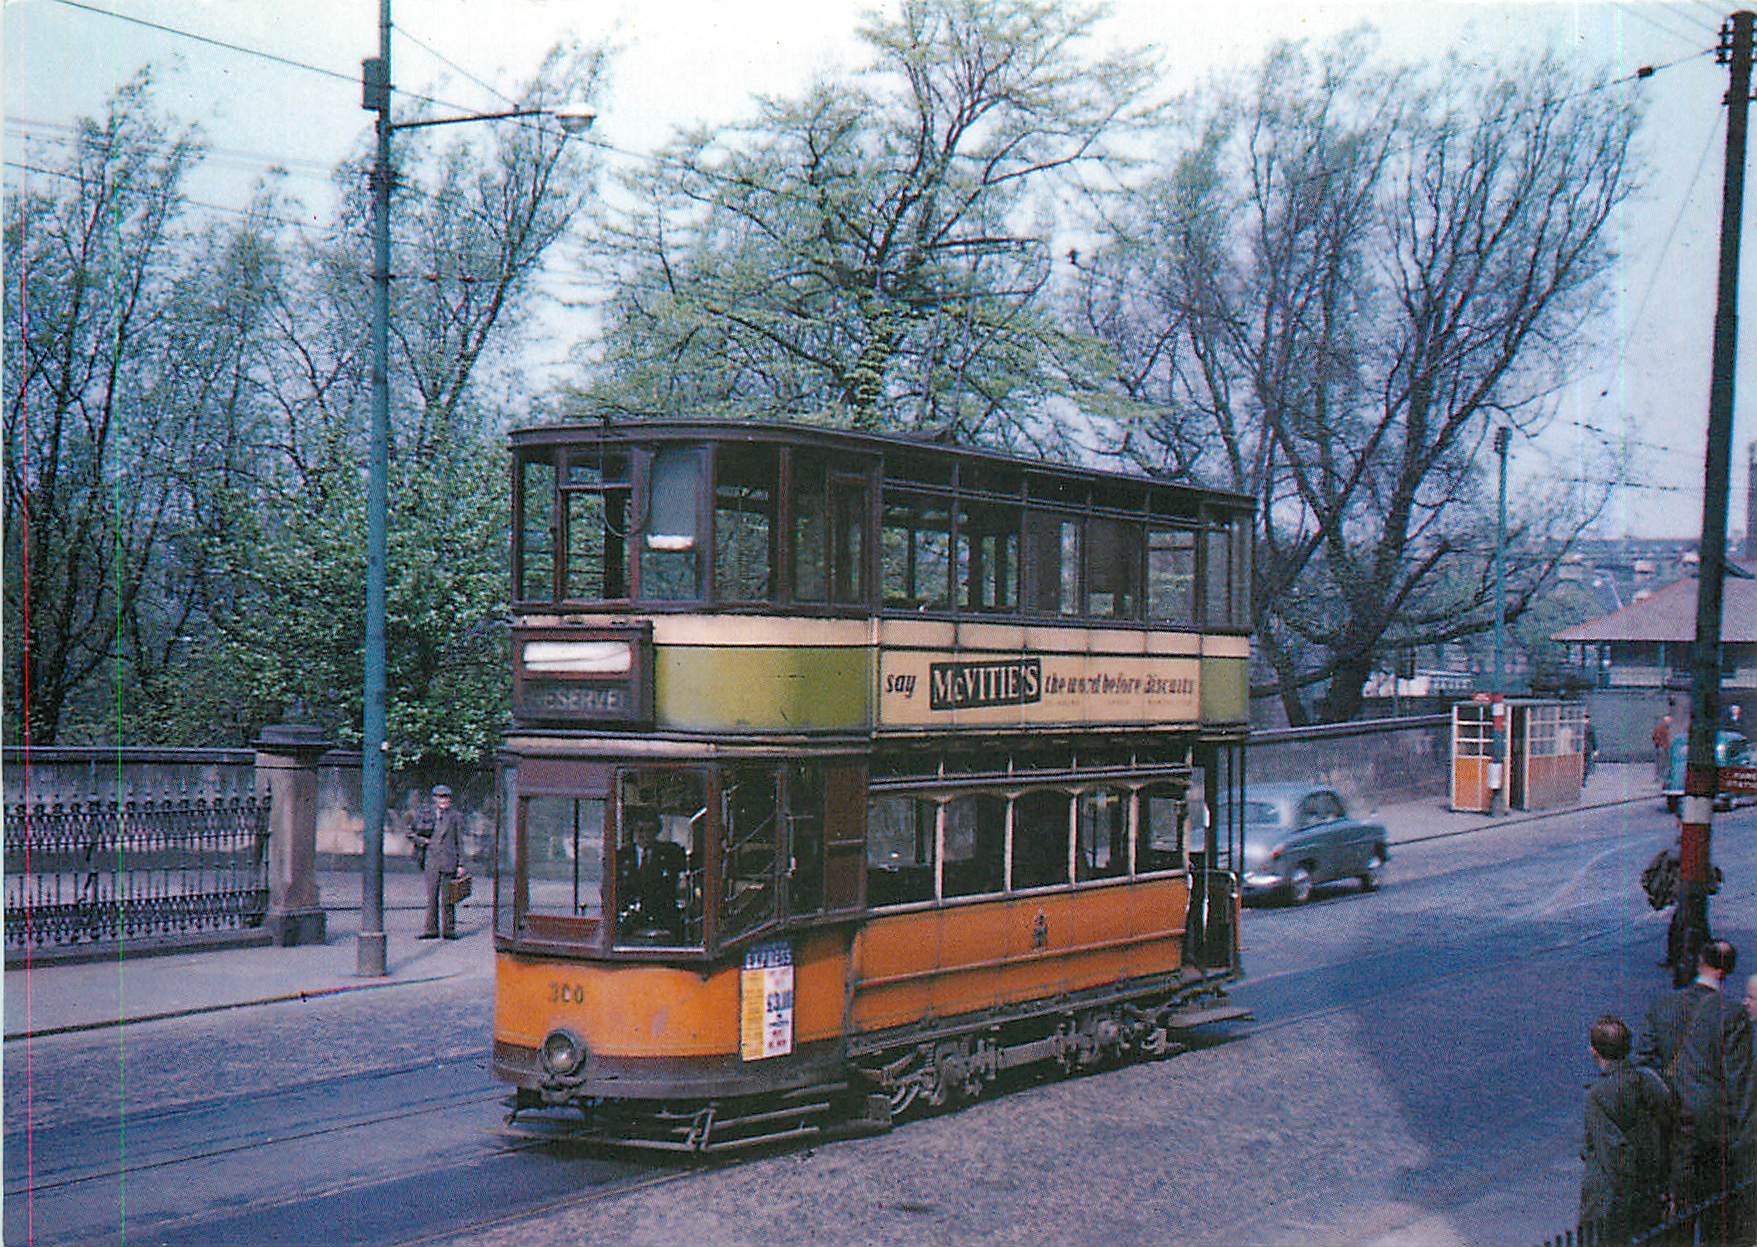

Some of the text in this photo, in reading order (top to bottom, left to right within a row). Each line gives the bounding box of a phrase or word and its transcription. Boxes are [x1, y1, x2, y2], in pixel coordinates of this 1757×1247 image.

[886, 673, 917, 698] say
[933, 664, 1039, 704] McVITIE'S
[1044, 672, 1066, 694] the
[1067, 672, 1102, 694] word
[1102, 672, 1142, 694] before
